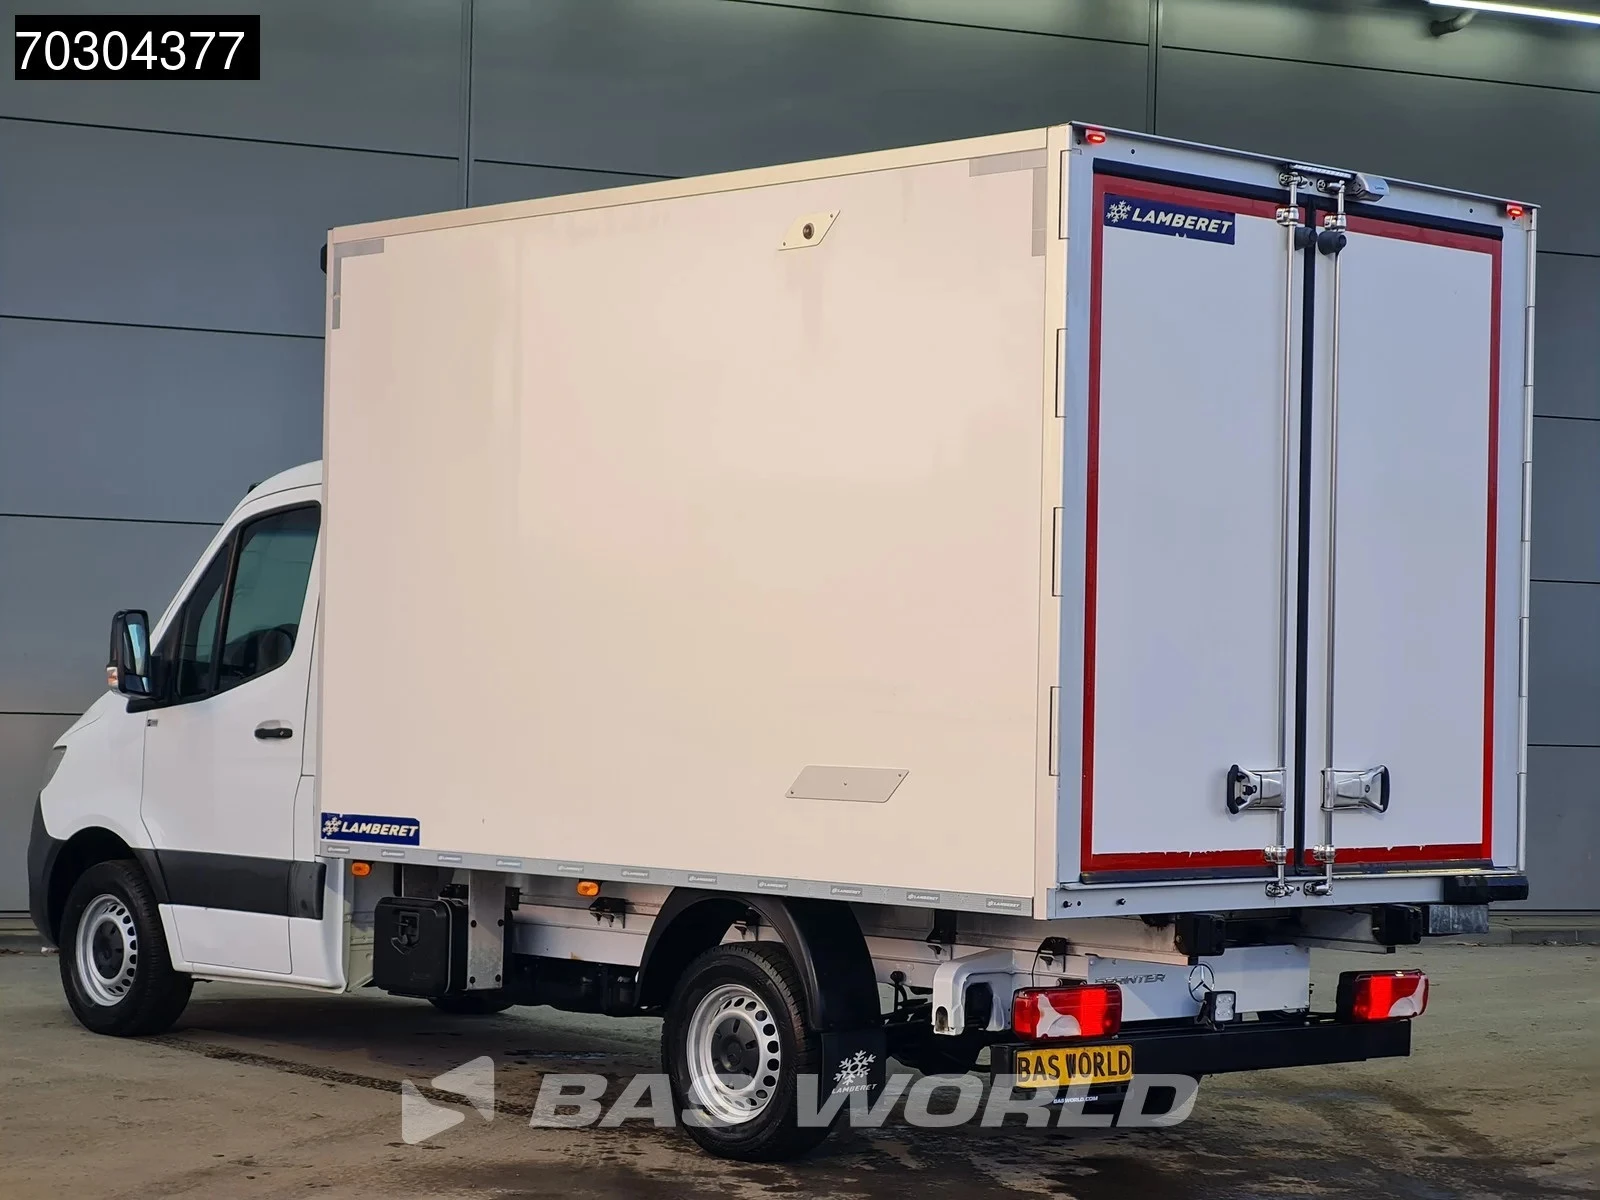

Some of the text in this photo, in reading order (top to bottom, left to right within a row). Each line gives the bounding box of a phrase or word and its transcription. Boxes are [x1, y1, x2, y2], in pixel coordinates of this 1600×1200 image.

[1131, 207, 1233, 235] LAMBERET
[340, 821, 419, 837] LAMBERET
[1017, 1049, 1131, 1083] BAS WORLD
[831, 1083, 878, 1095] LAMBERET
